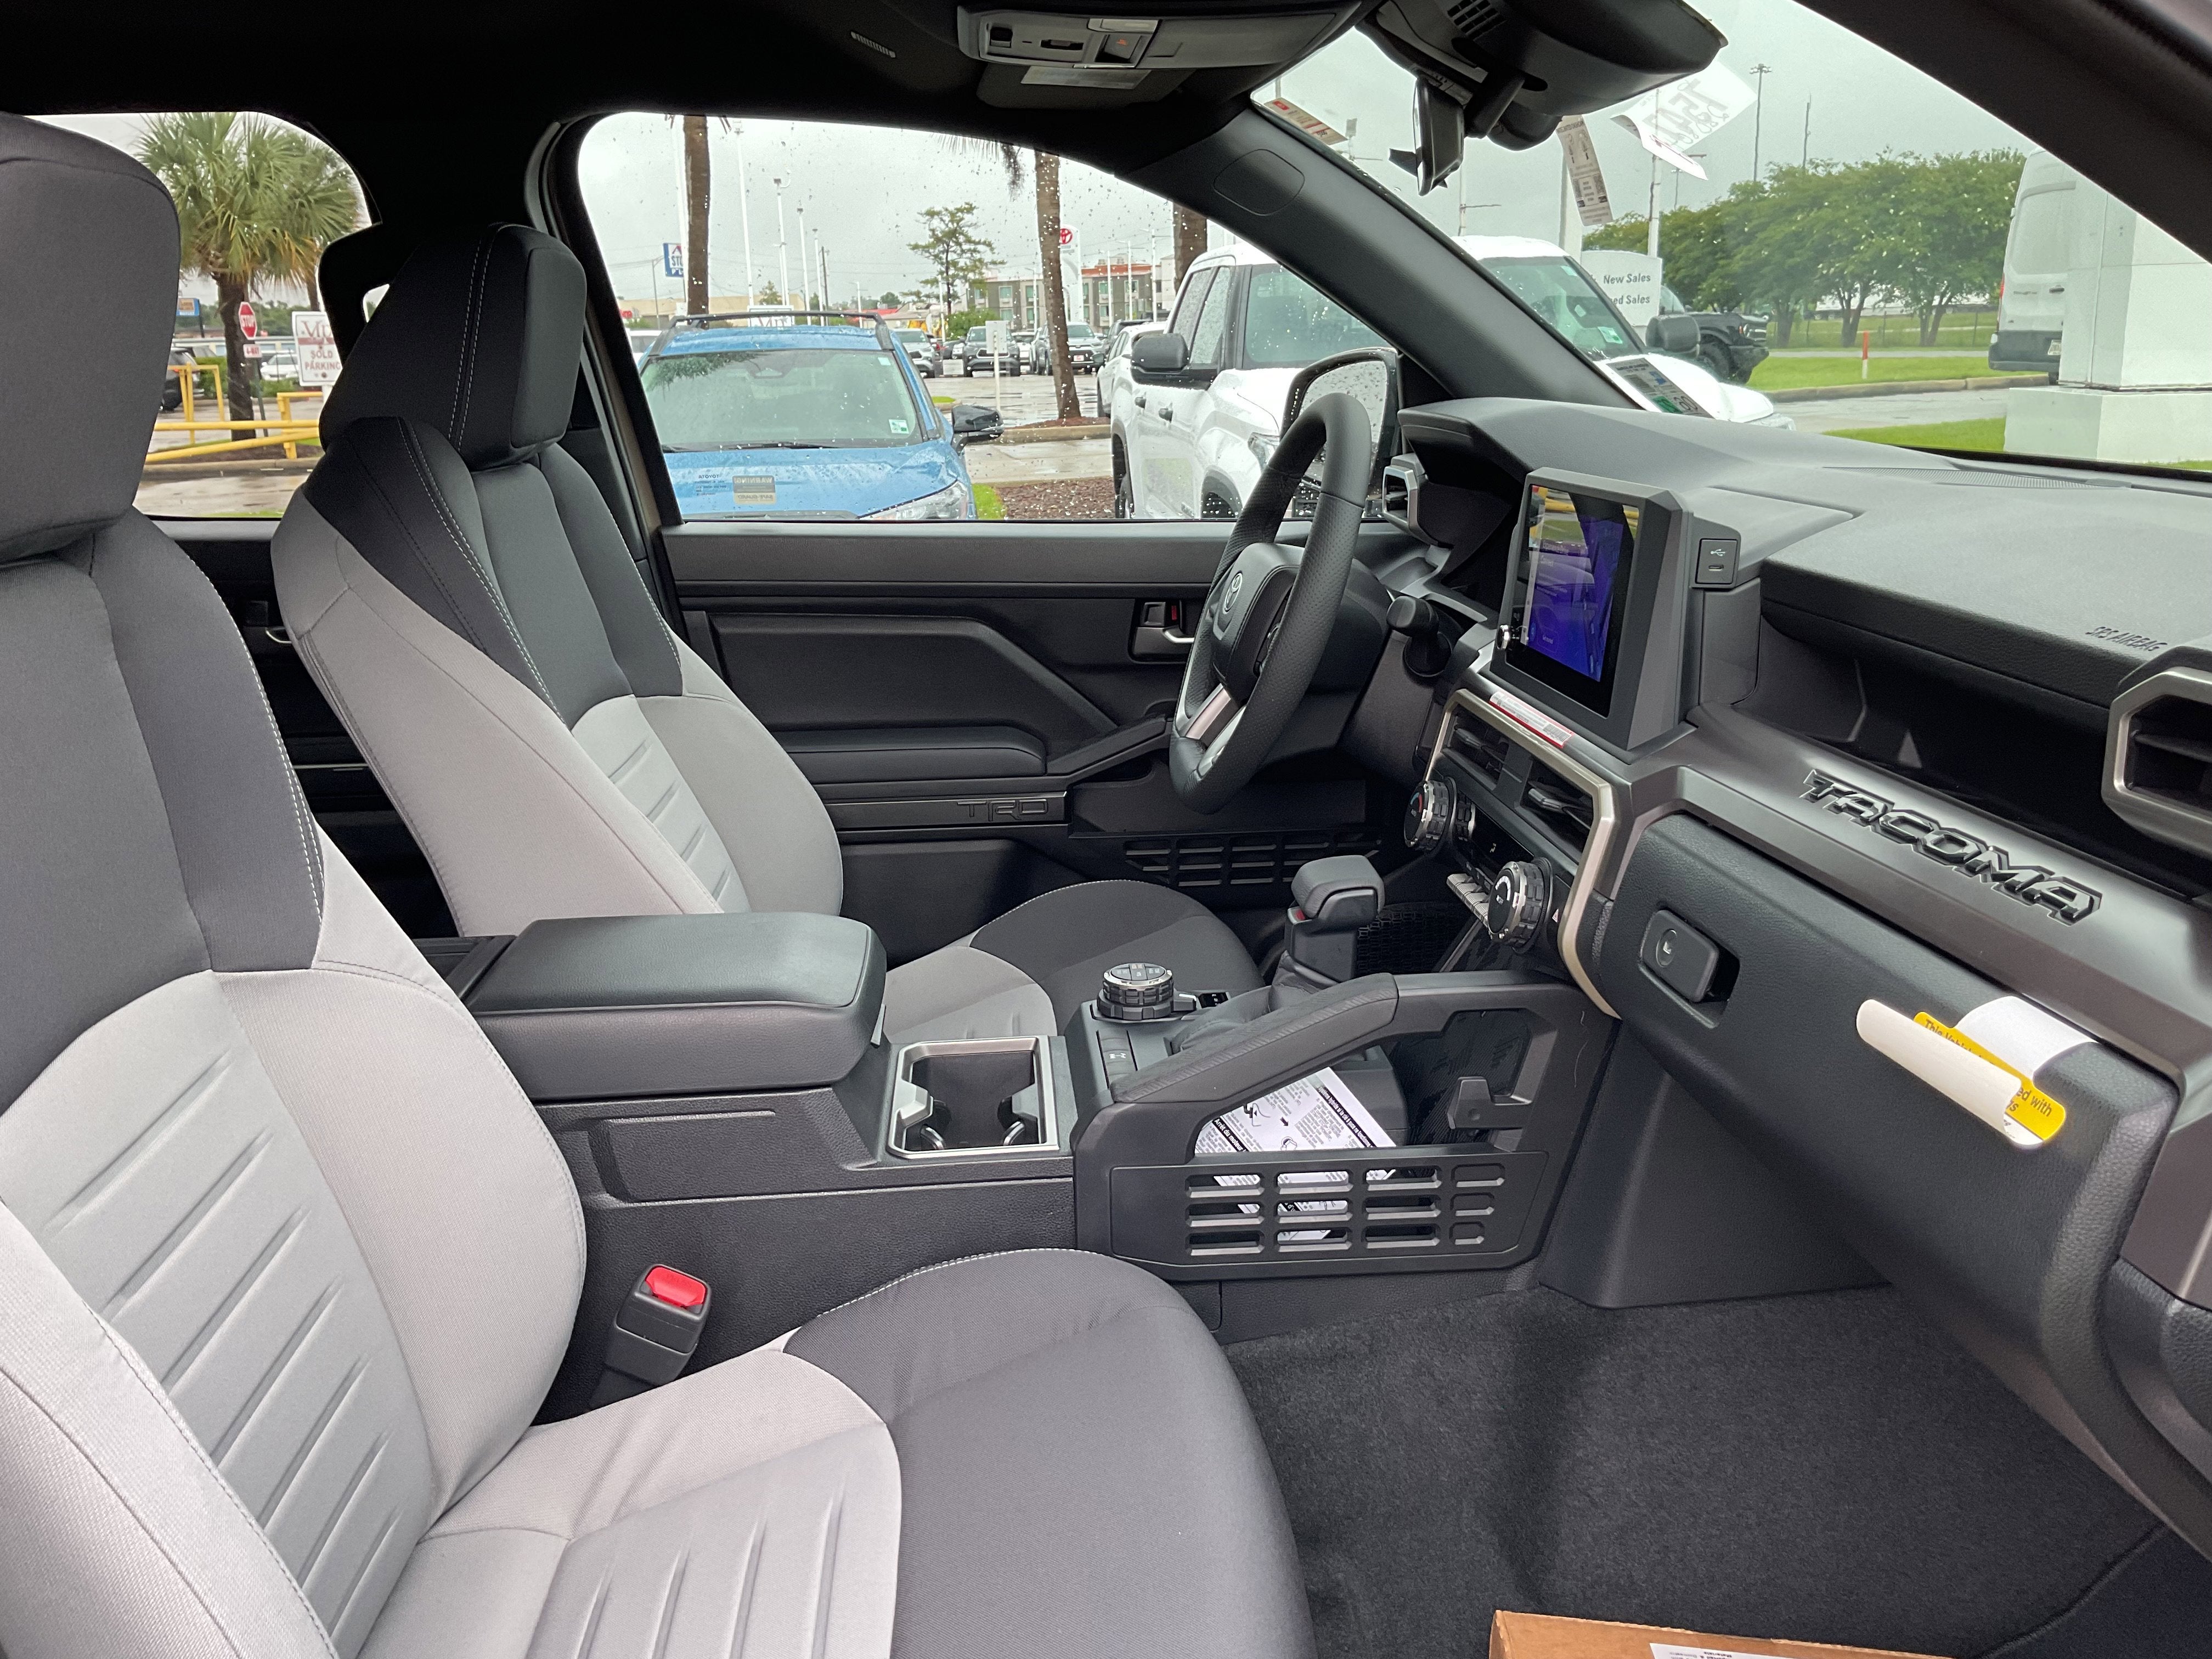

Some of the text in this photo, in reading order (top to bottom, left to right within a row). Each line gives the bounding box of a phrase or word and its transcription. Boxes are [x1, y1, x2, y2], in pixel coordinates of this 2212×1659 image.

[1603, 273, 1651, 284] New Sales
[1626, 295, 1650, 304] Sales
[240, 314, 255, 328] STOP
[311, 350, 333, 359] SOLD
[2085, 627, 2168, 651] SRS AIRBAG
[957, 798, 1048, 821] TRD
[1800, 769, 2102, 926] TACOMA
[2029, 1096, 2052, 1117] with
[1214, 1117, 1244, 1152] Arrêt du moteur
